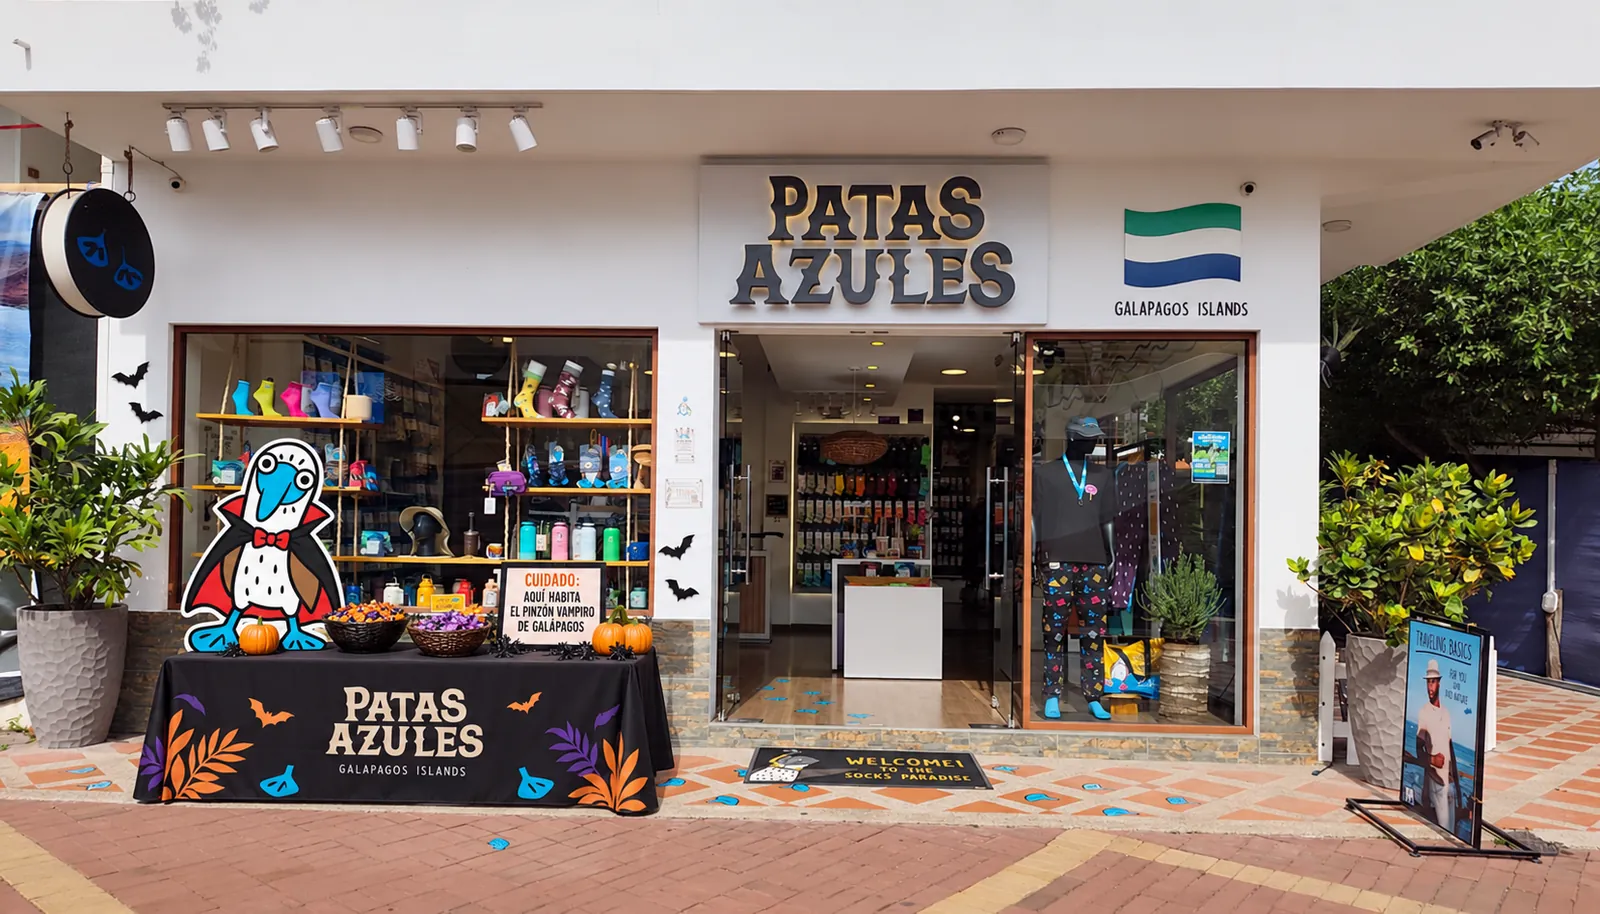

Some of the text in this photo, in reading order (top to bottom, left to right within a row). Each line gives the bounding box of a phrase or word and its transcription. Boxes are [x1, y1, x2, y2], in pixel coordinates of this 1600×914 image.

[768, 175, 985, 241] PATAS
[729, 241, 1016, 308] AZULES
[1114, 301, 1249, 317] GALAPAGOS ISLANDS
[525, 573, 580, 587] CUIDADO:
[523, 588, 581, 603] AQUÍ HABITA
[510, 603, 595, 618] EL PINZÓN VAMPIRO
[518, 618, 585, 633] DE GALÁPAGOS
[1416, 630, 1472, 660] TRAVELING BASICS
[343, 686, 468, 723] PATAS
[325, 723, 484, 758] AZULES
[338, 763, 467, 777] GALAPAGOS ISLANDS
[845, 772, 972, 782] SOCKS PARADISE
